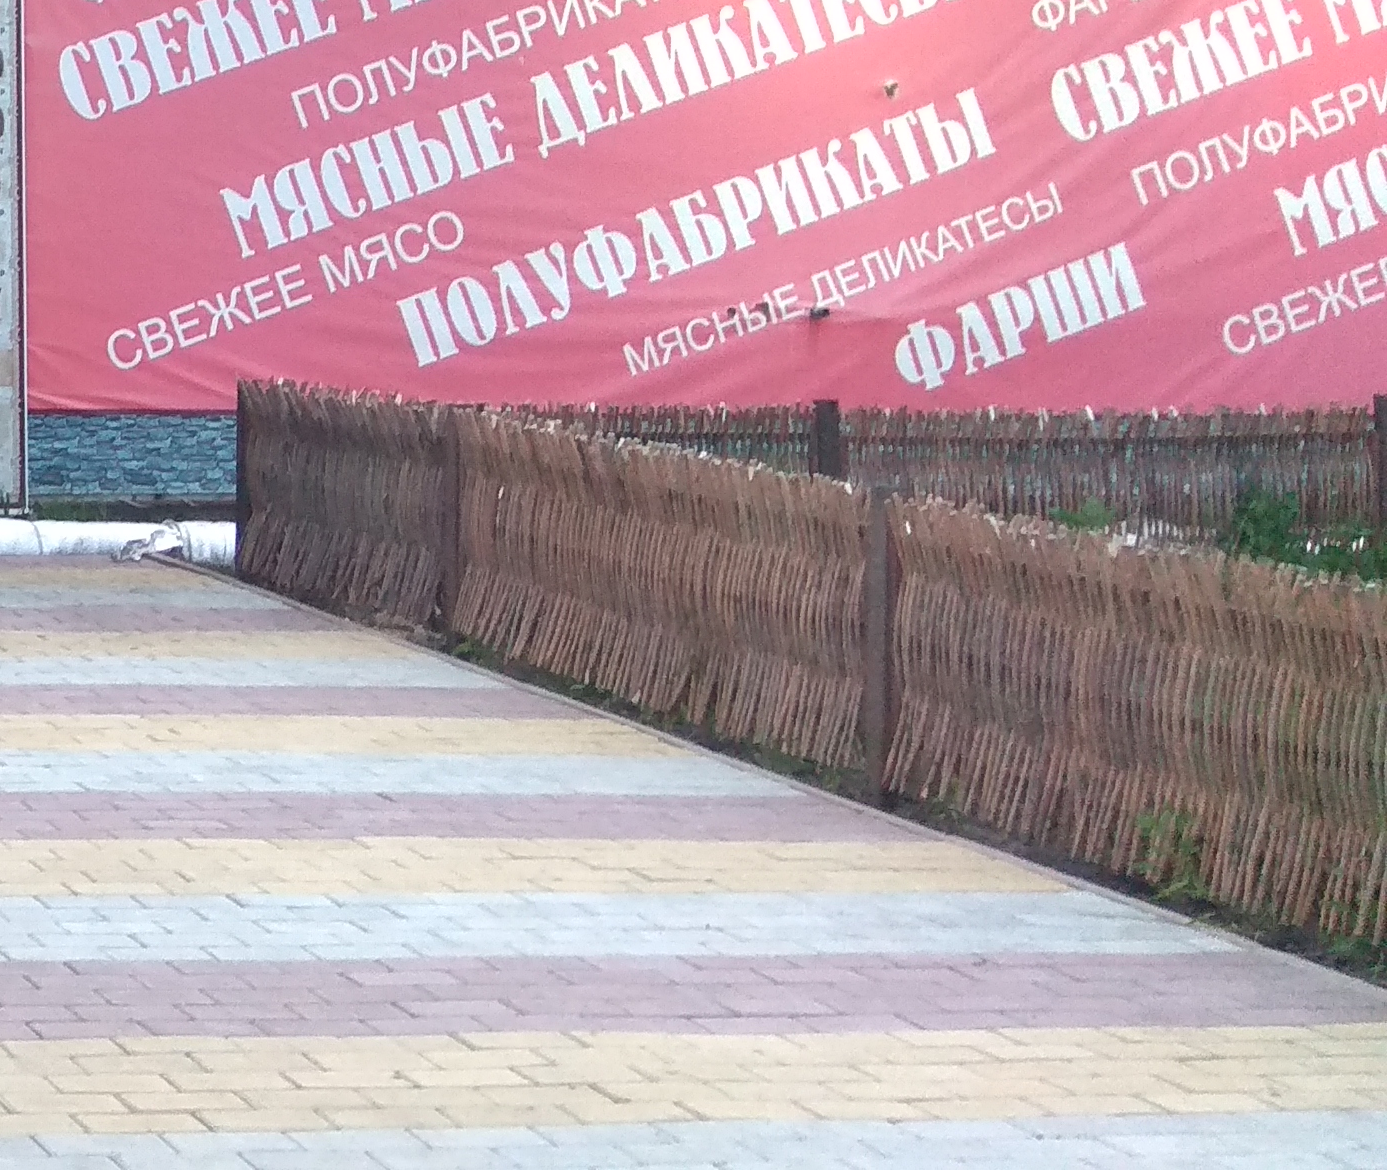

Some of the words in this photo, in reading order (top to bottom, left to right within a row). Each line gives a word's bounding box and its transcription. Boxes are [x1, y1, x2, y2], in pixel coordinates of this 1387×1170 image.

[218, 92, 515, 259] МЯСНЫЕ
[395, 87, 996, 368] ПОЛУФАБРИКАТЫ
[106, 263, 314, 371] СВЕЖЕЕ
[317, 210, 465, 295] МЯСО
[622, 282, 806, 377] МЯСНЫЕ
[811, 180, 1064, 315] ДЕЛИКАТЕСЫ
[893, 241, 1147, 392] ФАРШИ
[1222, 257, 1387, 356] СВЕЖЕ
